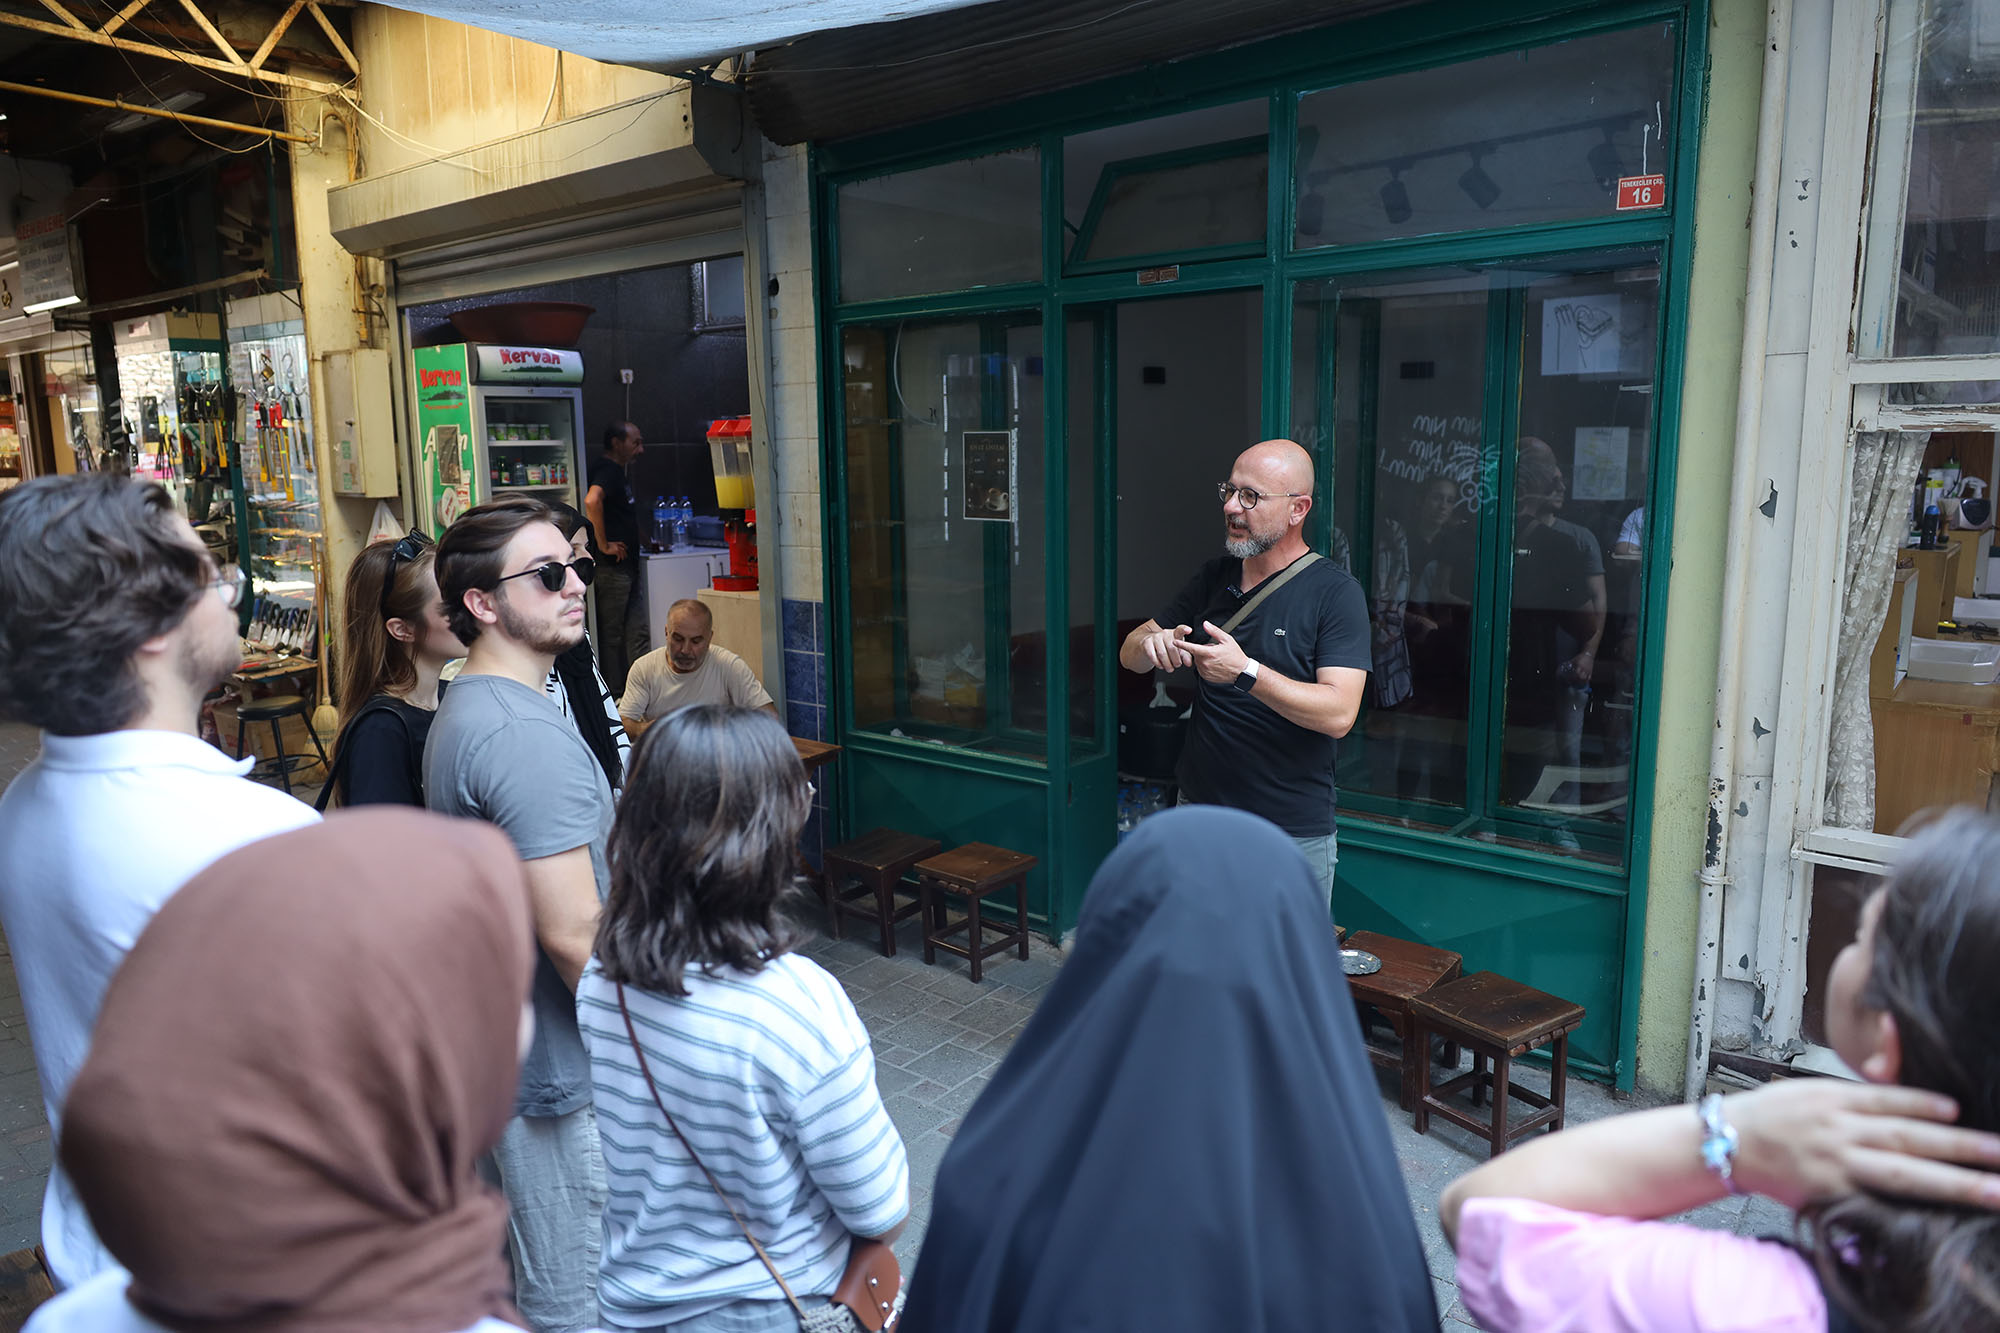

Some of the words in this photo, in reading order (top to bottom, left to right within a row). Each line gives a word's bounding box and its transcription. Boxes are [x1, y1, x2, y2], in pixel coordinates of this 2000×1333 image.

[1621, 179, 1653, 188] TENEKECİLER
[1632, 187, 1652, 204] 16
[500, 349, 561, 365] Kervan
[419, 368, 462, 388] Kervan
